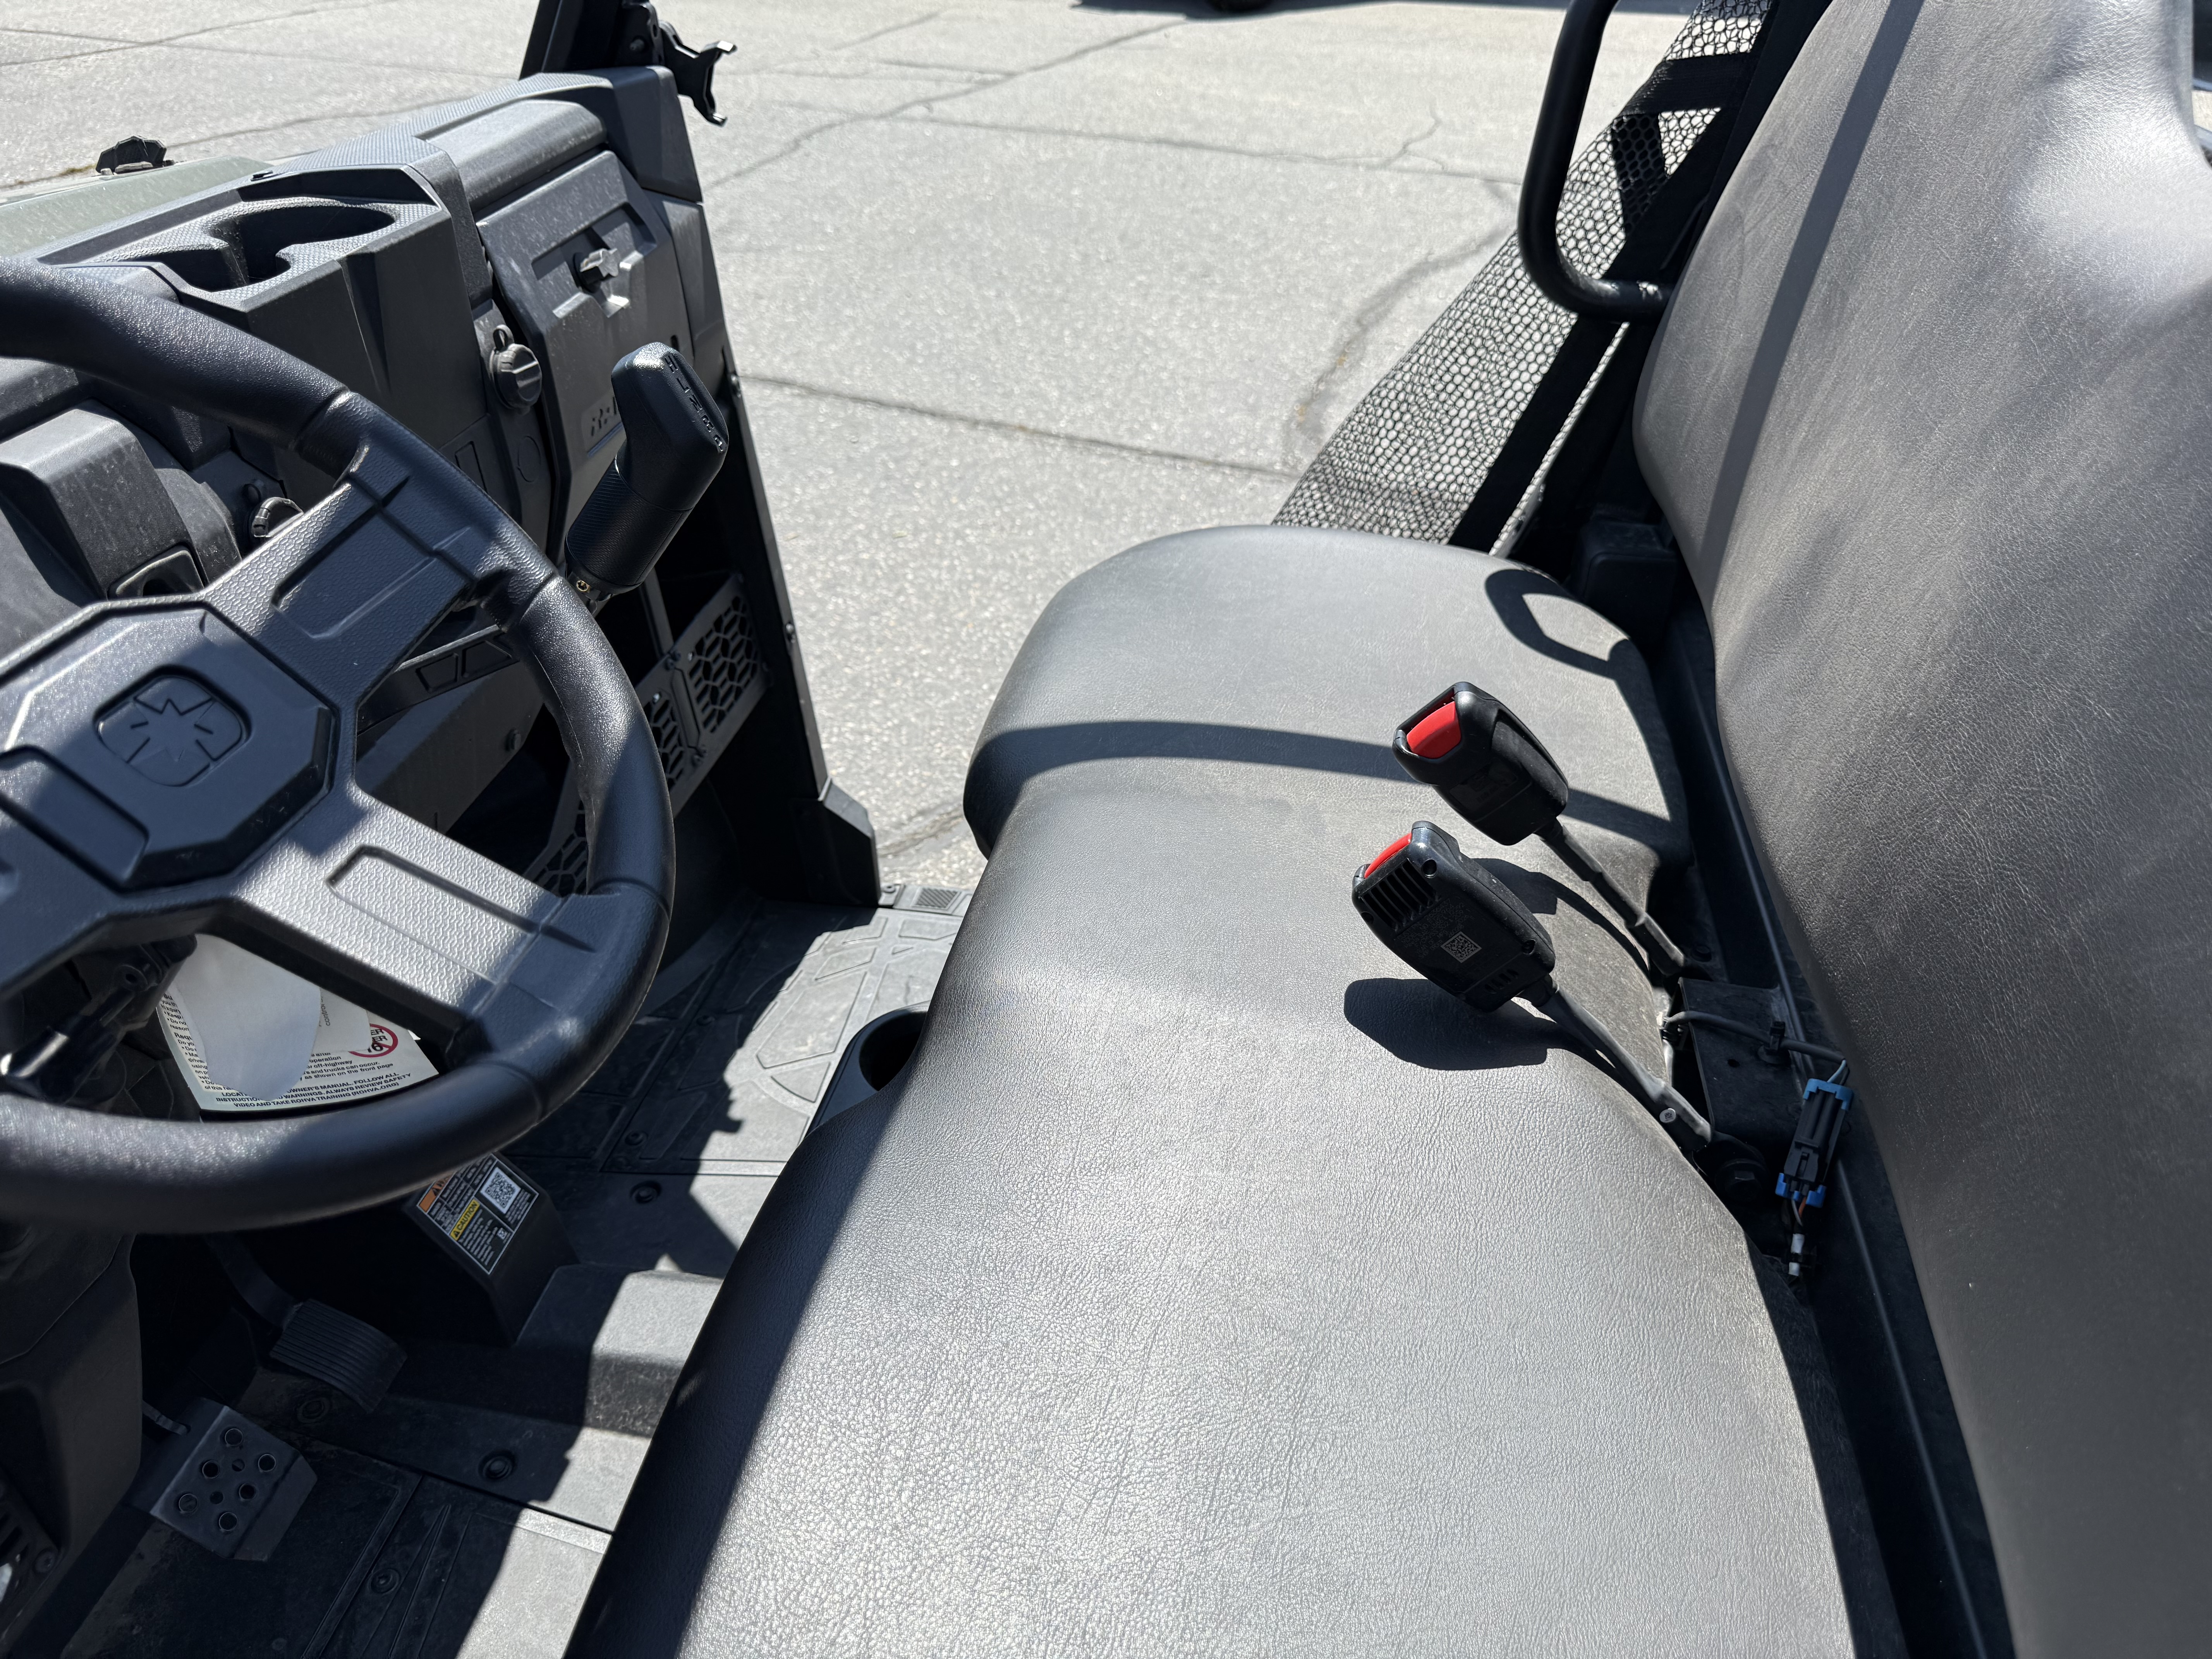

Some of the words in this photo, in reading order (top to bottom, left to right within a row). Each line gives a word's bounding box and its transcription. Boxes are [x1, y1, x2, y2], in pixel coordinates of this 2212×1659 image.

[676, 378, 691, 393] L
[354, 1075, 384, 1084] FOLLOW
[355, 1081, 383, 1090] REVIEW
[384, 1073, 410, 1084] SAFETY
[316, 1092, 351, 1101] TRAINING
[457, 1202, 478, 1231] CAUTION
